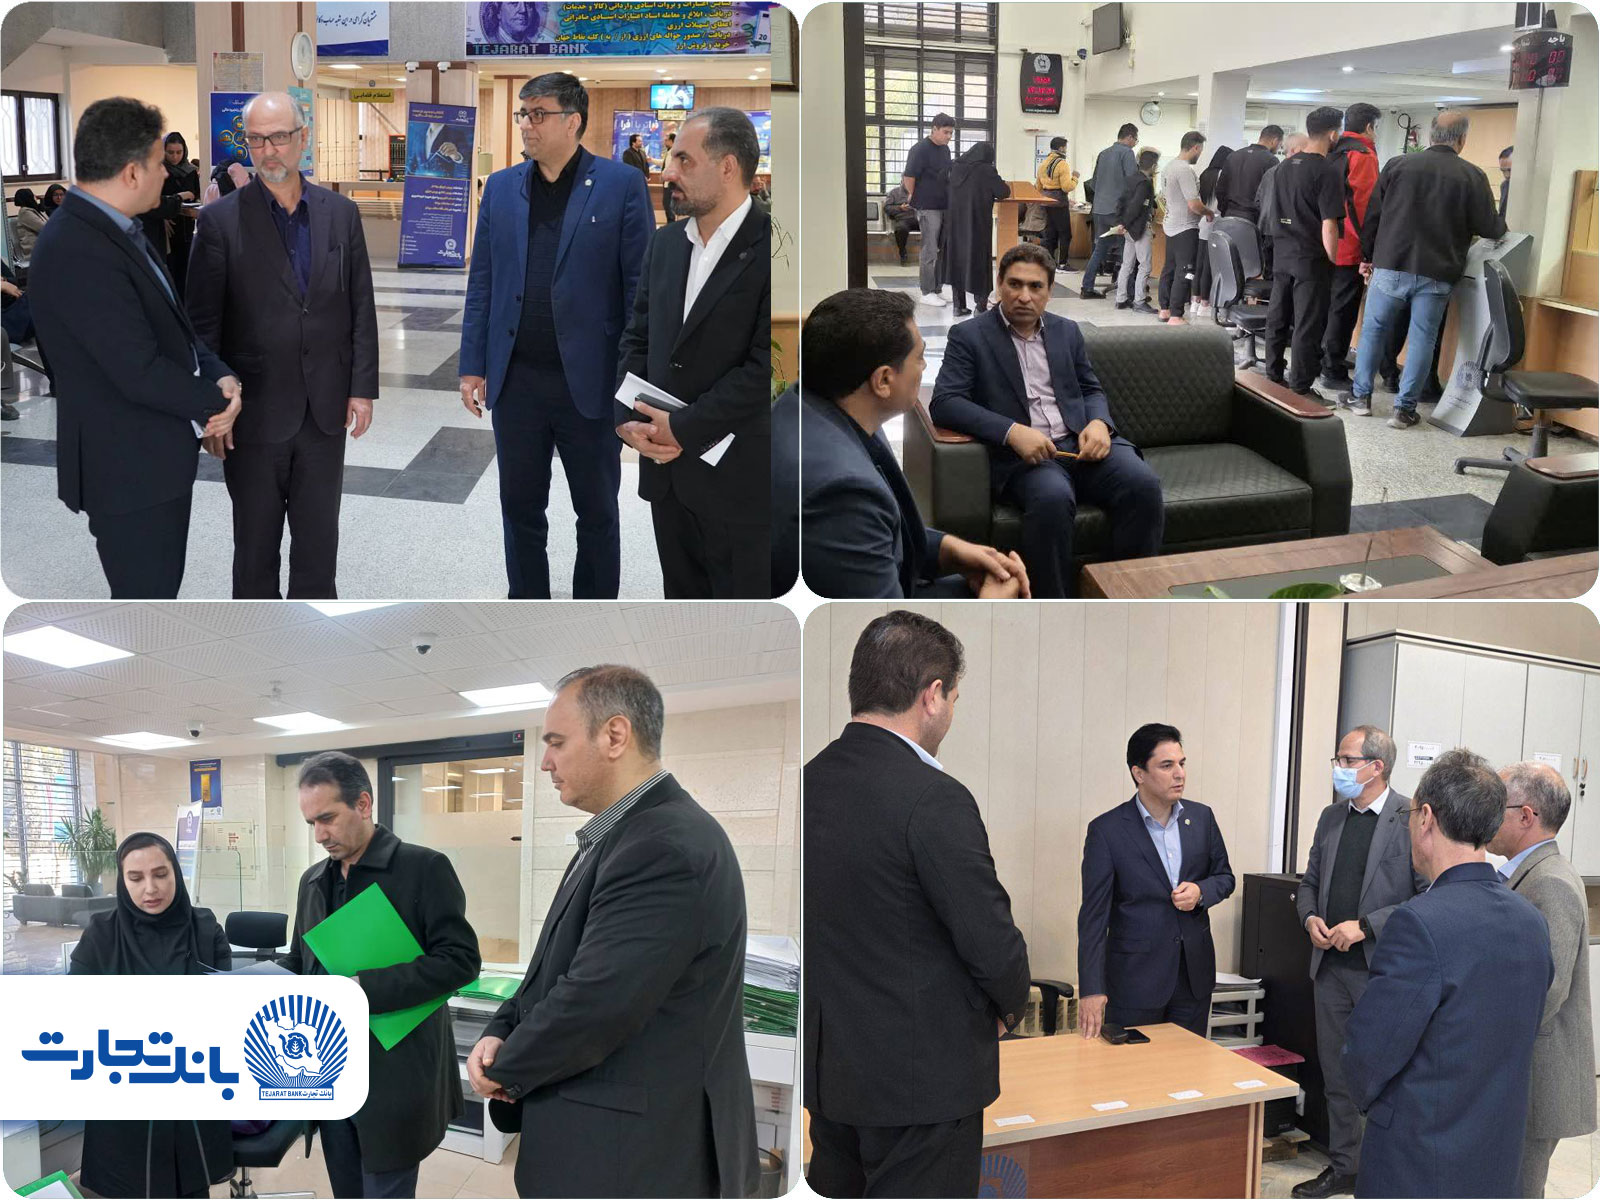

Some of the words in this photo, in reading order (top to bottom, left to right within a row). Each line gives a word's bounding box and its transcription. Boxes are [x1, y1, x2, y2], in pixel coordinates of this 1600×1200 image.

[563, 13, 589, 22] صادراتی
[590, 13, 616, 22] اسنادی
[618, 12, 643, 21] اعتبارات
[687, 10, 703, 19] ابلاغ
[709, 10, 733, 18] دریافت
[667, 22, 684, 31] ارزی
[685, 21, 710, 29] تسهیلات
[710, 20, 733, 30] اعطای
[554, 34, 571, 42] جهان
[572, 33, 586, 41] نقاط
[587, 32, 599, 41] کلیه
[632, 32, 649, 41] ارزی
[664, 32, 681, 40] حواله
[683, 33, 701, 41] صدور
[708, 31, 731, 39] دریافت
[758, 33, 768, 41] 20
[1547, 34, 1566, 46] باجه
[473, 43, 539, 55] TEJARAT
[549, 43, 590, 54] BANK
[676, 43, 685, 51] ارز
[687, 42, 706, 51] فروش
[713, 41, 730, 49] خرید
